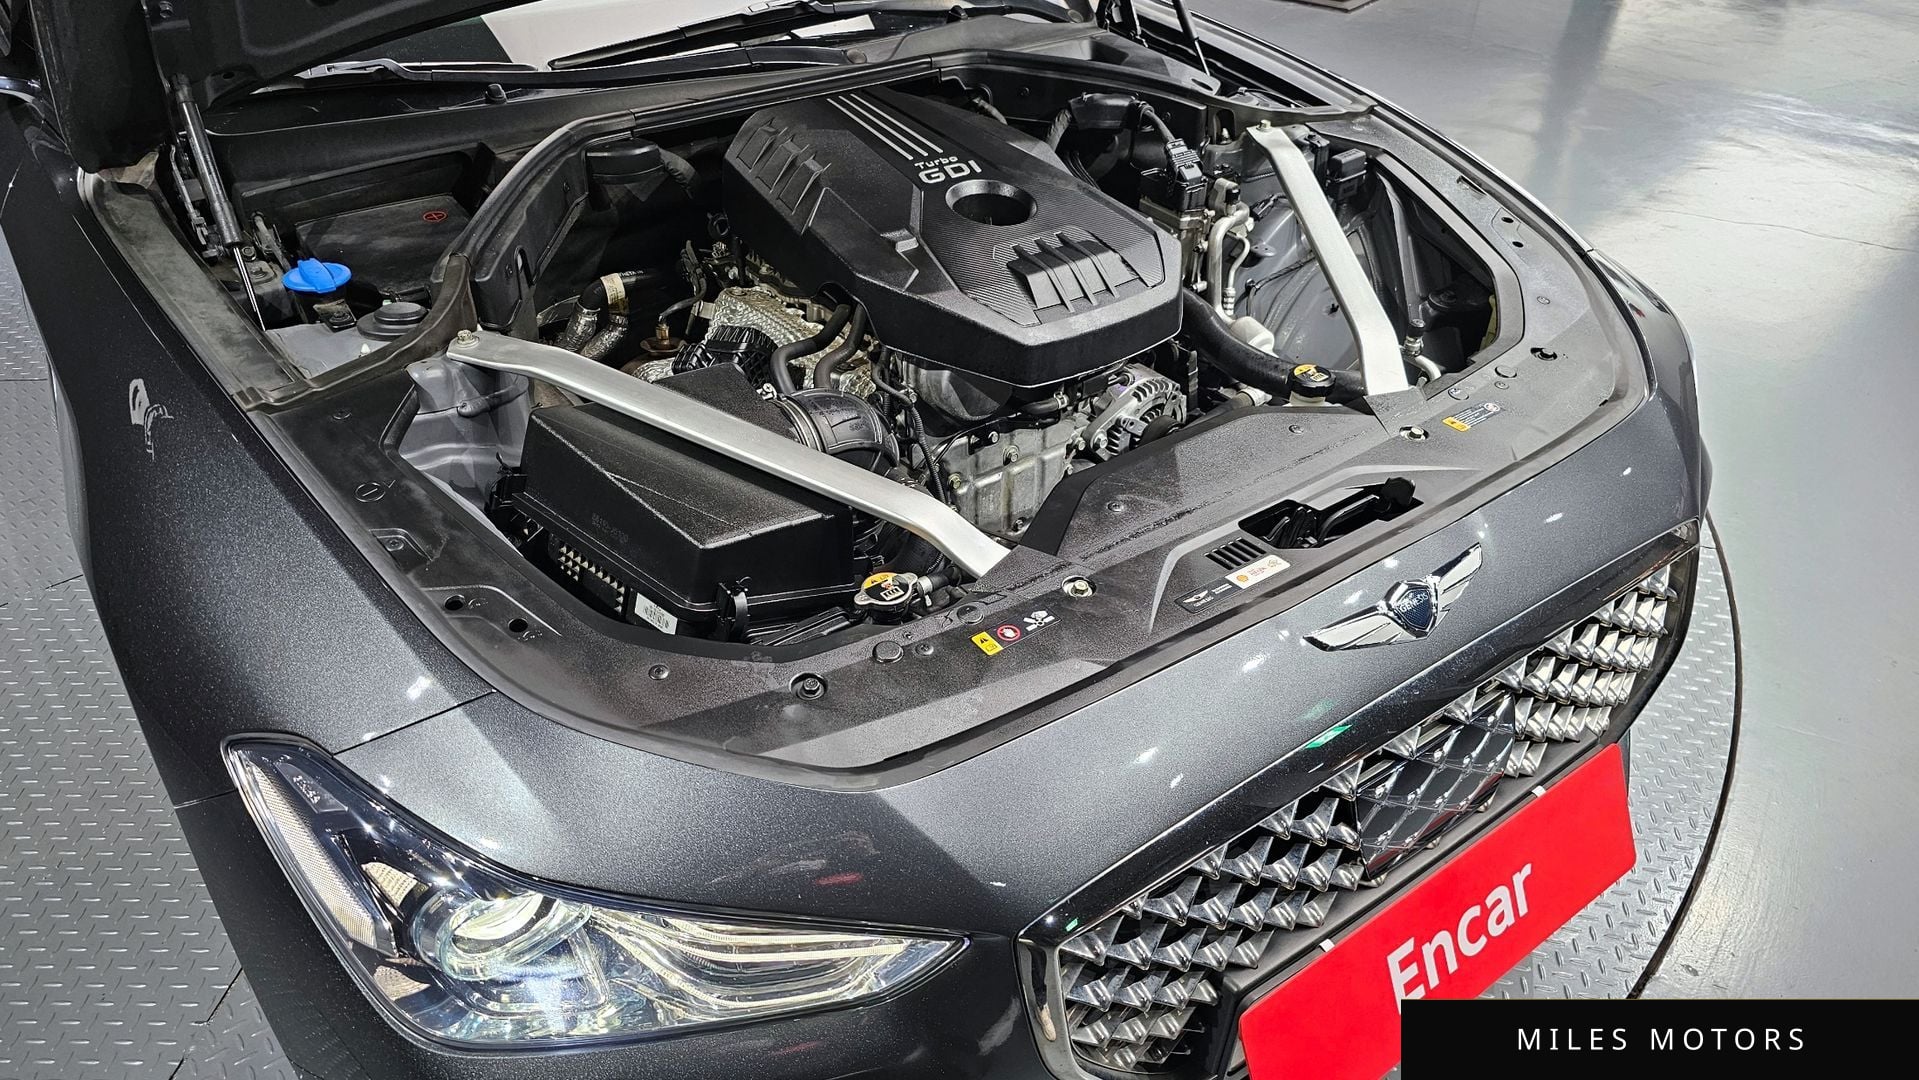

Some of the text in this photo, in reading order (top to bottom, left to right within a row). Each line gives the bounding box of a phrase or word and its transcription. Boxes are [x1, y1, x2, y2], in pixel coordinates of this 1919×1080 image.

[914, 156, 959, 170] Turbo
[918, 159, 983, 184] GDI
[1399, 592, 1430, 613] GENESIS
[1386, 863, 1532, 1016] Encar
